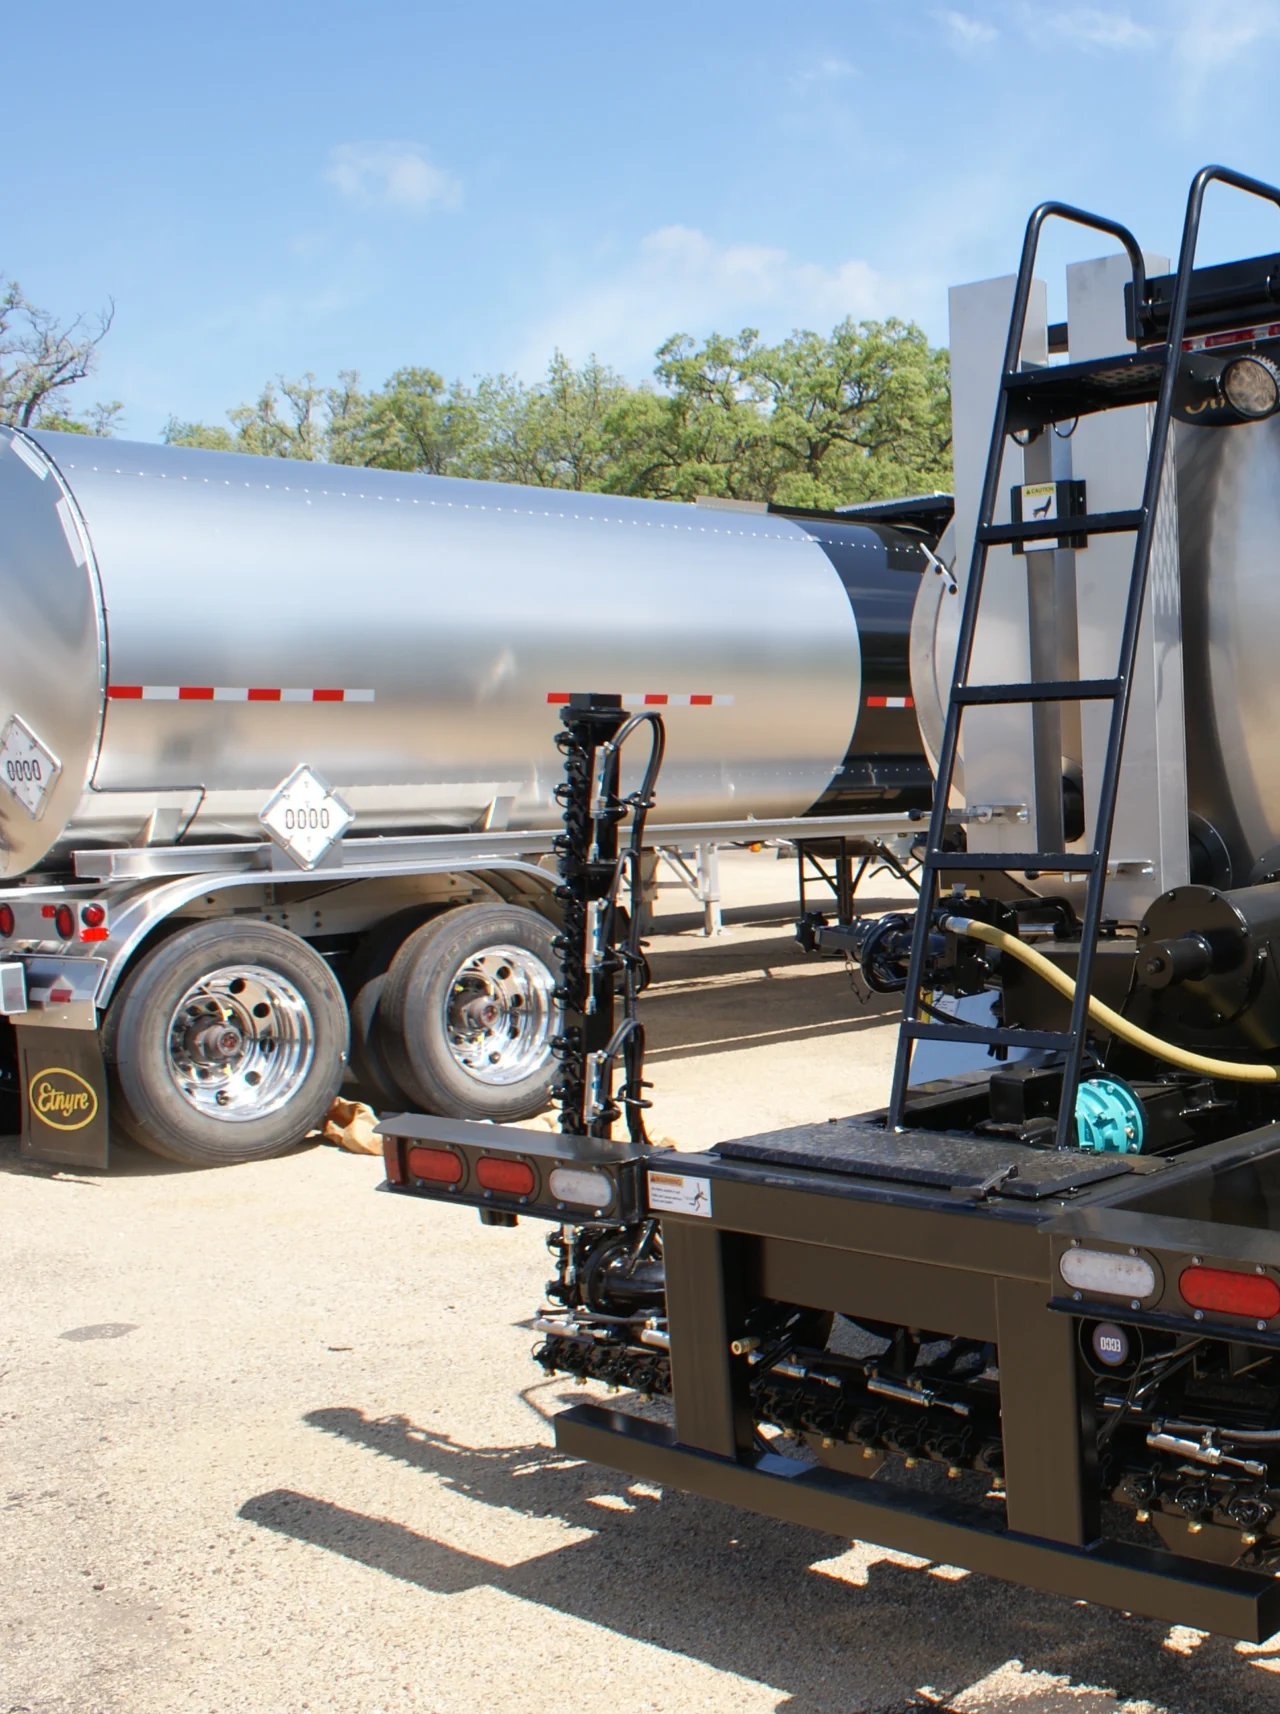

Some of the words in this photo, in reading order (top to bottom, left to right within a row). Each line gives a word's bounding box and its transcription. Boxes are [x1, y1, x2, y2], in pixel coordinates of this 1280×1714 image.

[1031, 486, 1054, 494] CAUTION
[7, 759, 42, 782] 0000
[285, 808, 330, 830] 0000
[38, 1082, 89, 1117] Etnyre
